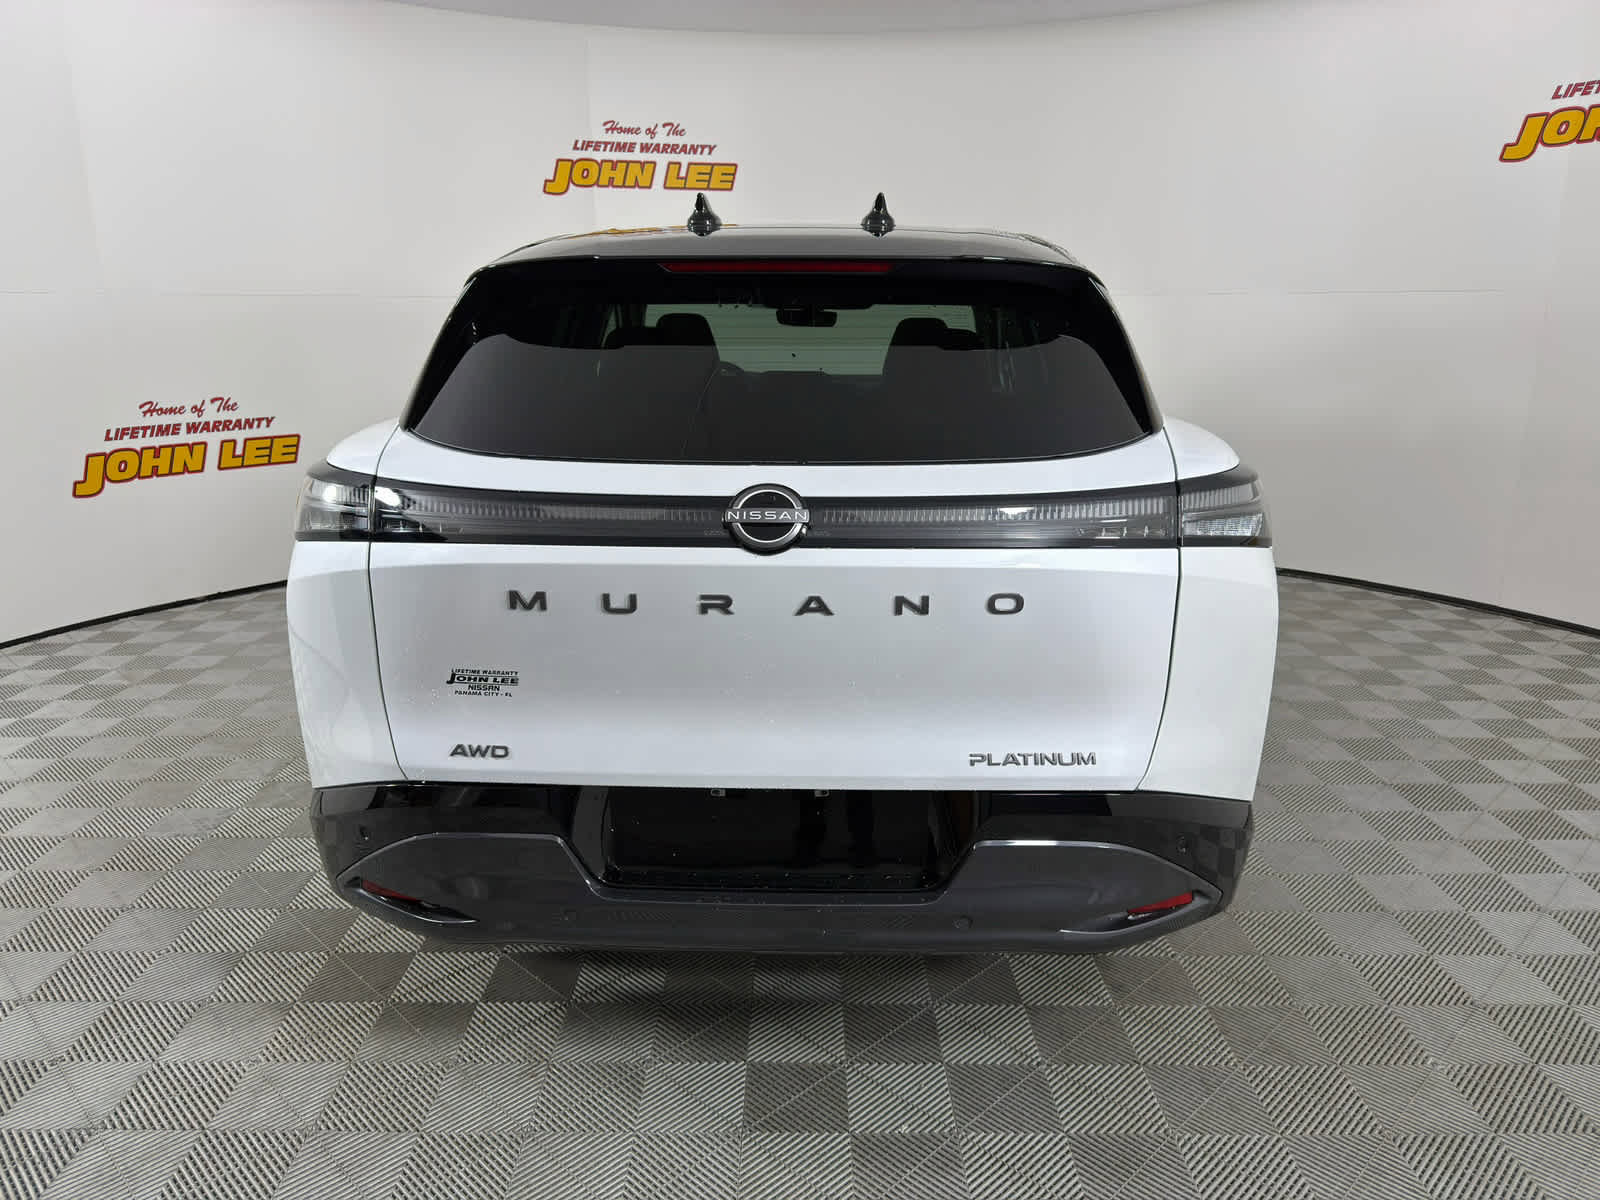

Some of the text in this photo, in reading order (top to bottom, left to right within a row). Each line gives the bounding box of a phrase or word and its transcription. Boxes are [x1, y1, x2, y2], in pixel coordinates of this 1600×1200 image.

[602, 120, 686, 139] Home of The
[572, 140, 717, 156] LIFETIME WARRANTY
[543, 158, 738, 195] JOHN LEE
[138, 397, 239, 417] Home of The
[104, 416, 275, 442] LIFETIME WARRANTY
[72, 434, 300, 498] JOHN LEE
[727, 511, 808, 521] NISSAN
[507, 590, 1025, 616] MURANO
[446, 672, 489, 684] JOHN
[450, 743, 509, 758] AWD
[968, 752, 1097, 767] PLATINUM
